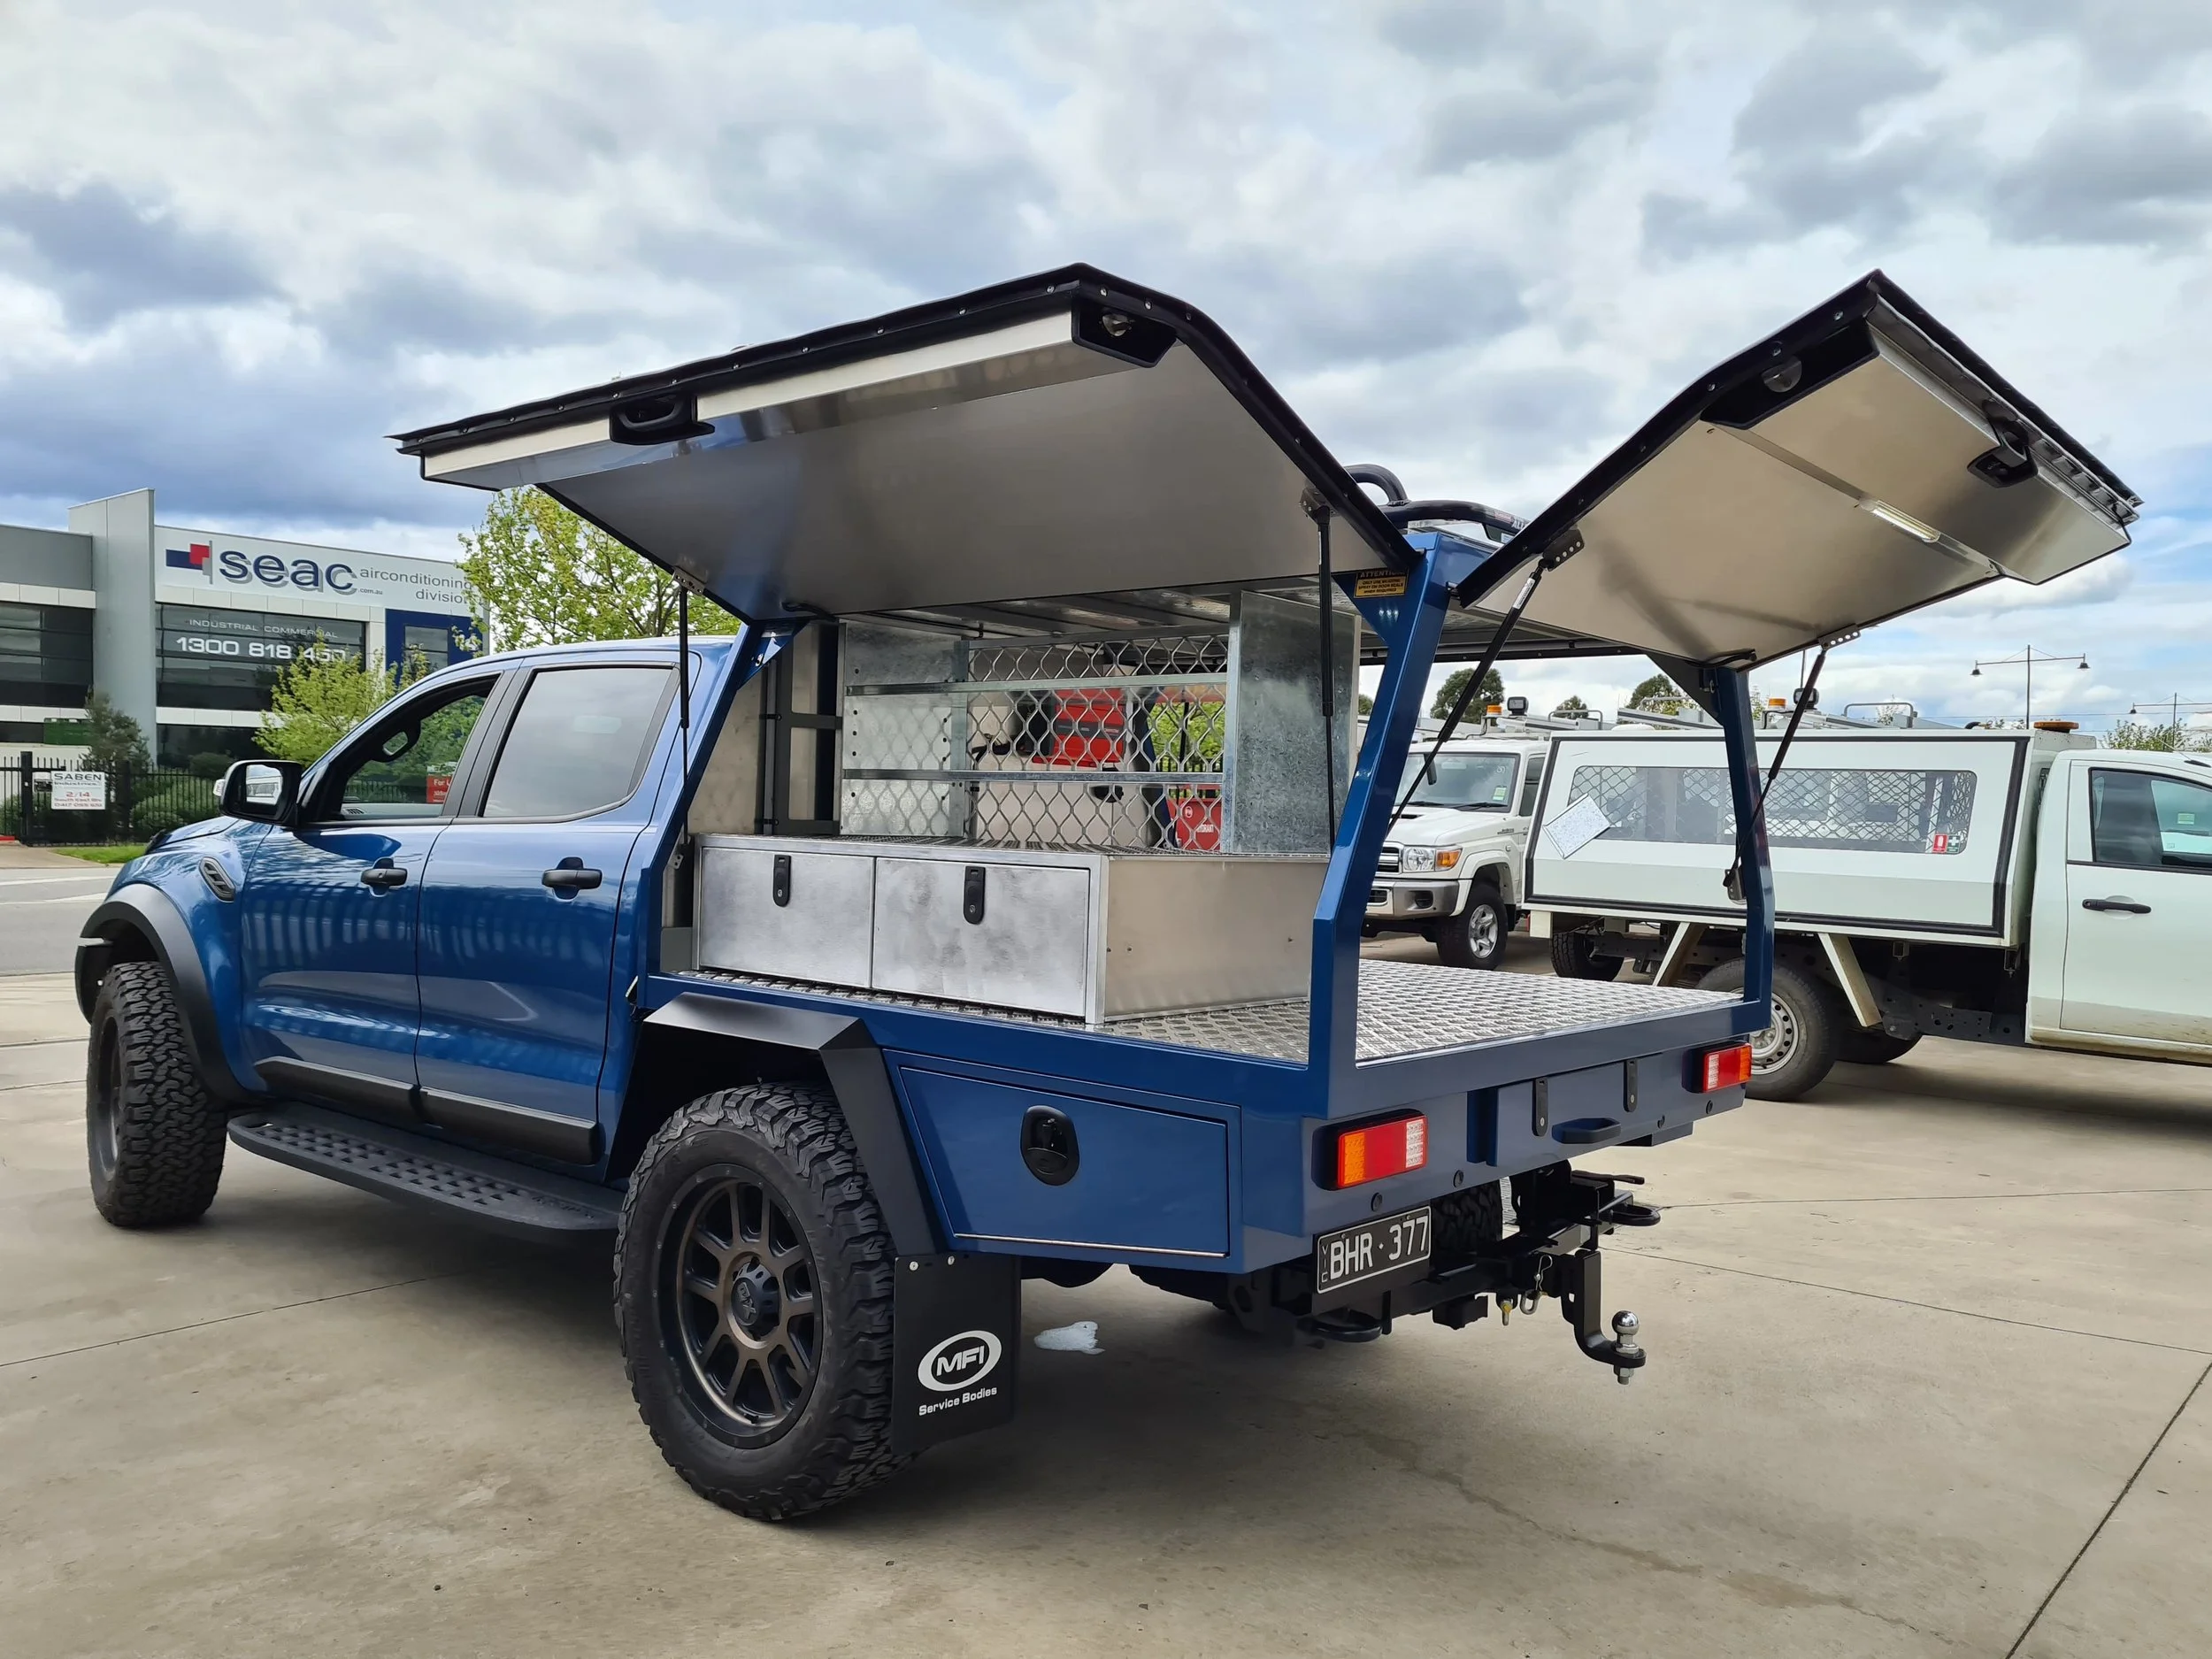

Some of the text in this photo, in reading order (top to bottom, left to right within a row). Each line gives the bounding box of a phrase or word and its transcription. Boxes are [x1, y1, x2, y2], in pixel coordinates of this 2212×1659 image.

[219, 550, 356, 593] seac
[359, 566, 472, 590] airconditioning
[415, 588, 468, 604] divisio
[188, 619, 259, 632] INDUSTRIAL
[177, 636, 240, 656] 1300
[249, 641, 292, 660] 818
[1330, 1233, 1373, 1280] BHR
[1388, 1216, 1428, 1261] 377
[936, 1345, 985, 1377] MFI
[918, 1386, 998, 1417] Service Bodies
